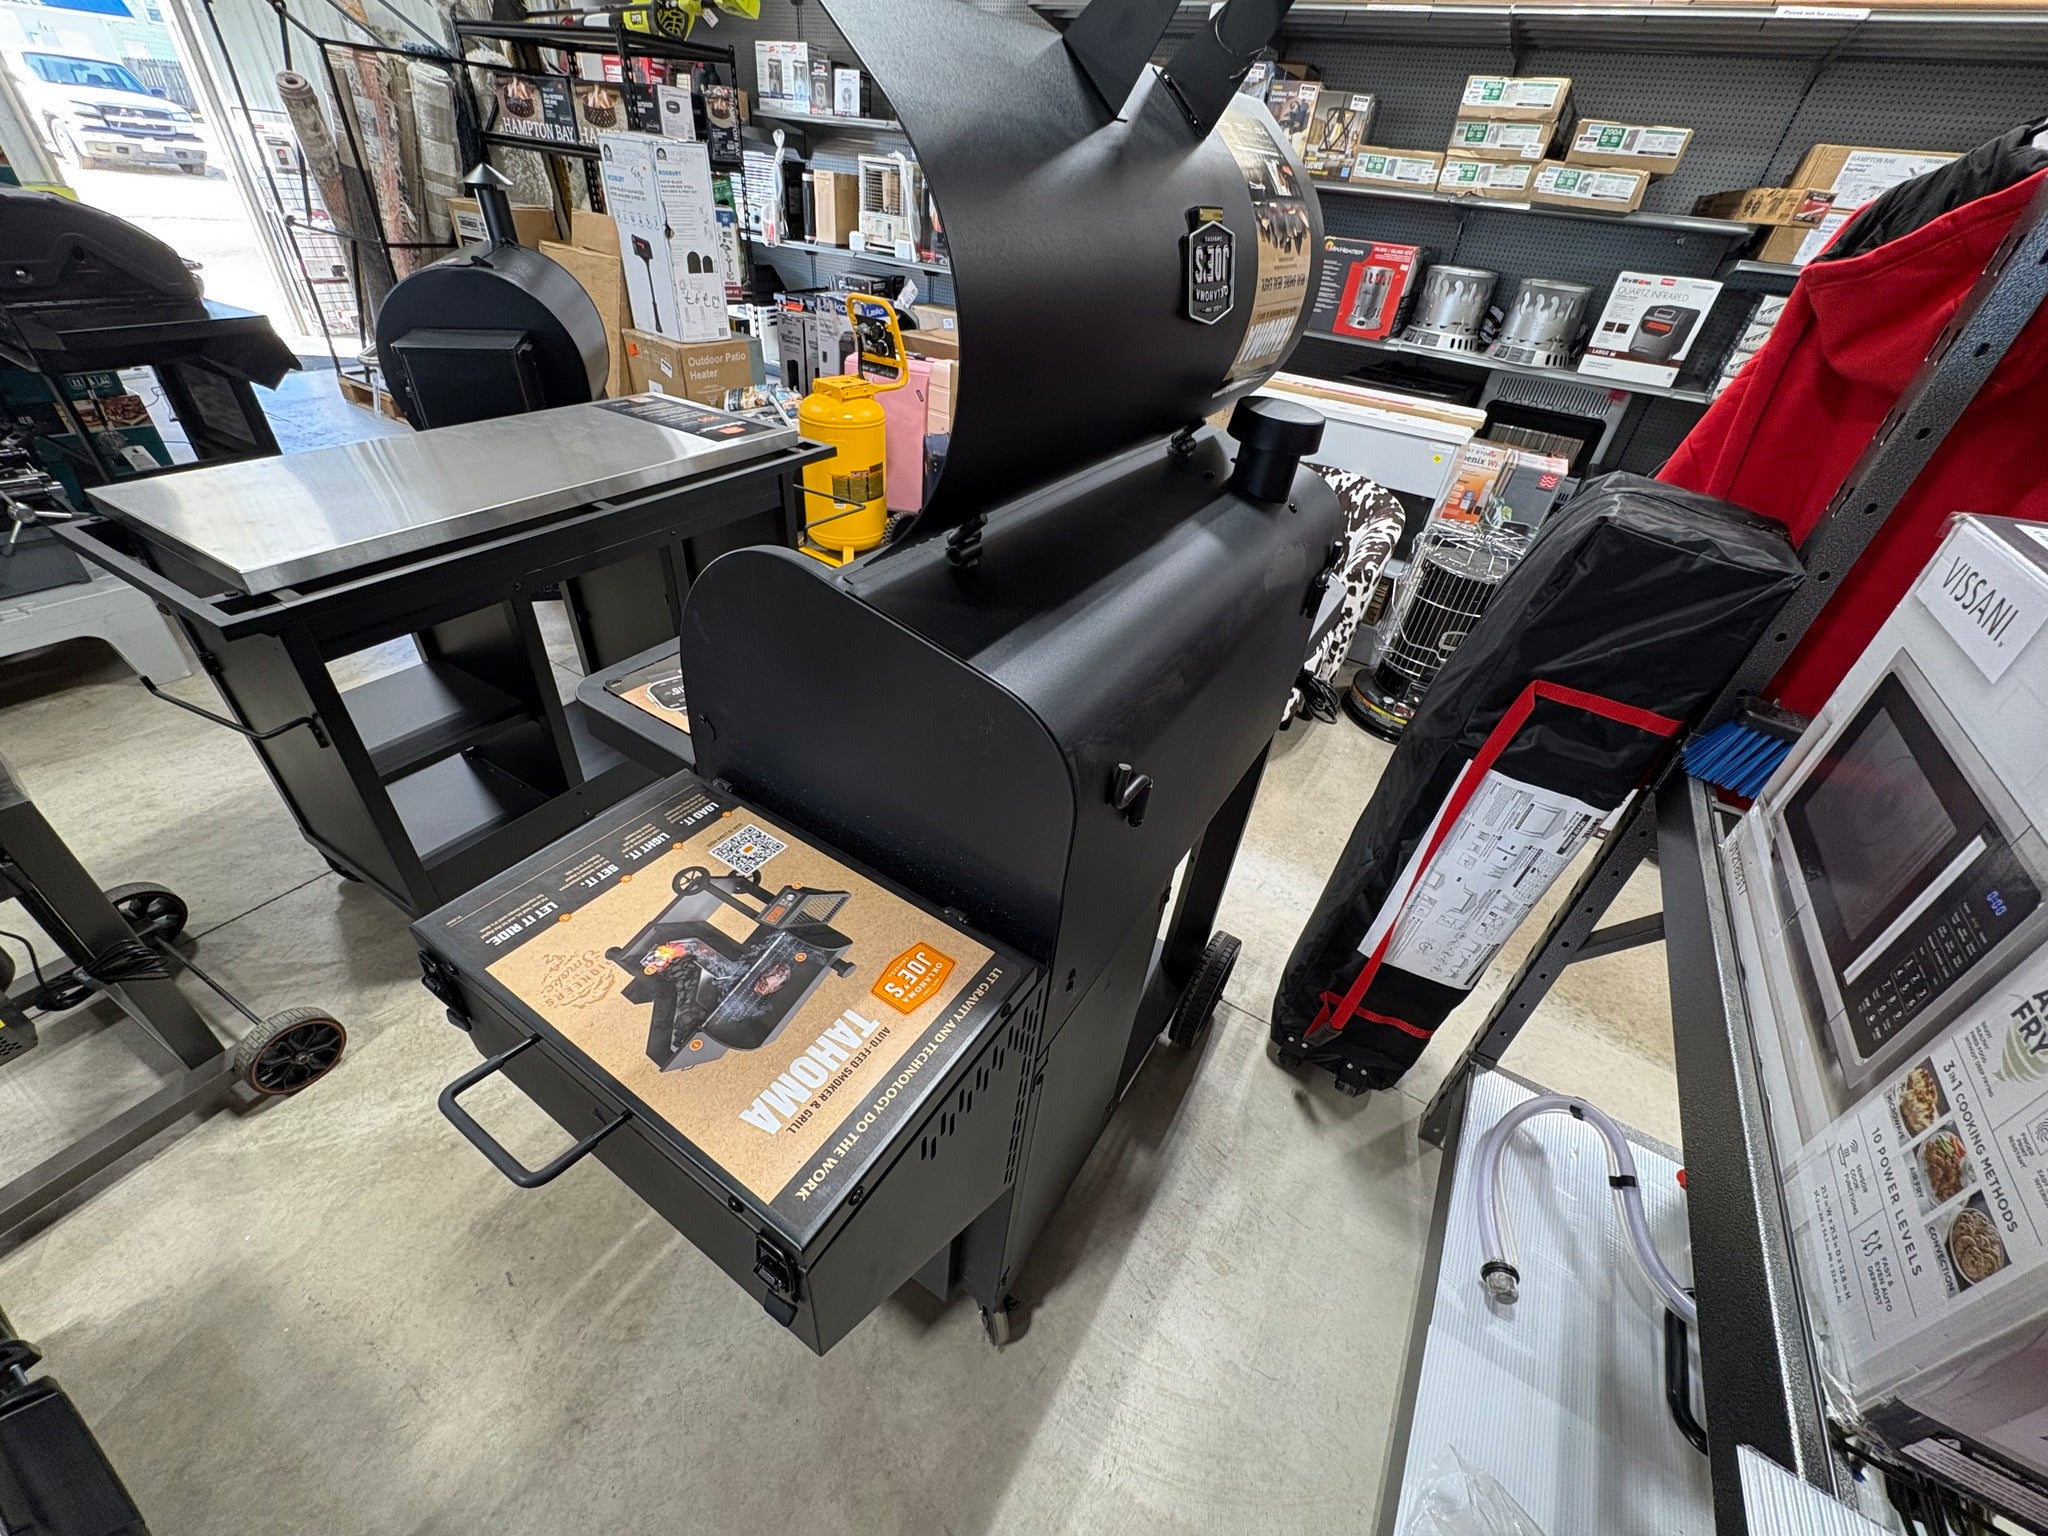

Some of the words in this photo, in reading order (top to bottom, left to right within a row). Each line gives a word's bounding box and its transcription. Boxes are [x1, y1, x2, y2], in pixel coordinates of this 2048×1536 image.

[1486, 81, 1503, 90] 200A
[502, 117, 554, 140] HAMPTON
[555, 124, 576, 144] BAY
[1603, 128, 1623, 136] 200A
[1560, 171, 1578, 179] 200A
[1195, 244, 1230, 284] JOE'S
[1195, 285, 1229, 303] OKLAHOMA
[1617, 285, 1651, 298] QUARTZ
[1650, 289, 1690, 302] INFRARED
[866, 307, 884, 317] Lasko
[688, 355, 724, 368] Outdoor
[724, 351, 747, 362] Patio
[1592, 347, 1609, 357] LARGE
[689, 369, 719, 381] Heater
[679, 814, 695, 827] IT.
[691, 801, 720, 819] LOAD
[624, 847, 643, 861] IT.
[638, 832, 671, 853] LIGHT
[579, 875, 598, 888] IT.
[594, 864, 620, 882] SET
[521, 912, 538, 926] IT
[536, 900, 559, 919] LET
[484, 922, 524, 946] RIDE.
[883, 951, 932, 999] JOE'S
[901, 961, 943, 1003] OKLAHOMA
[984, 967, 1002, 985] LET
[948, 980, 989, 1022] GRAVITY
[936, 1016, 958, 1042] AND
[2010, 1000, 2048, 1055] FRY
[850, 1026, 891, 1069] AUTO-FEED
[739, 1008, 881, 1135] TAHOMA
[872, 1036, 939, 1114] TECHNOLOGY
[819, 1065, 853, 1103] SMOKER
[786, 1107, 814, 1134] GRILL
[856, 1111, 877, 1133] DO
[1886, 1094, 1906, 1140] MICROWAVE
[833, 1131, 860, 1158] THE
[1872, 1126, 1883, 1144] 10
[1908, 1165, 1919, 1183] AIR
[1955, 1092, 1986, 1156] COOKING
[1980, 1156, 2018, 1234] METHODS
[795, 1155, 839, 1202] WORK
[1849, 1168, 1861, 1191] COOK
[1856, 1163, 1868, 1194] SENSOR
[1876, 1148, 1901, 1206] POWER
[1844, 1173, 1859, 1216] FUNCTIONS
[1913, 1182, 1925, 1199] FRY
[1894, 1208, 1923, 1278] LEVELS
[1881, 1256, 1892, 1278] FAST
[1928, 1226, 1956, 1293] CONVECTION
[1867, 1265, 1884, 1306] DEFROST
[1874, 1260, 1885, 1286] EVEN
[1881, 1286, 1893, 1313] AUTO
